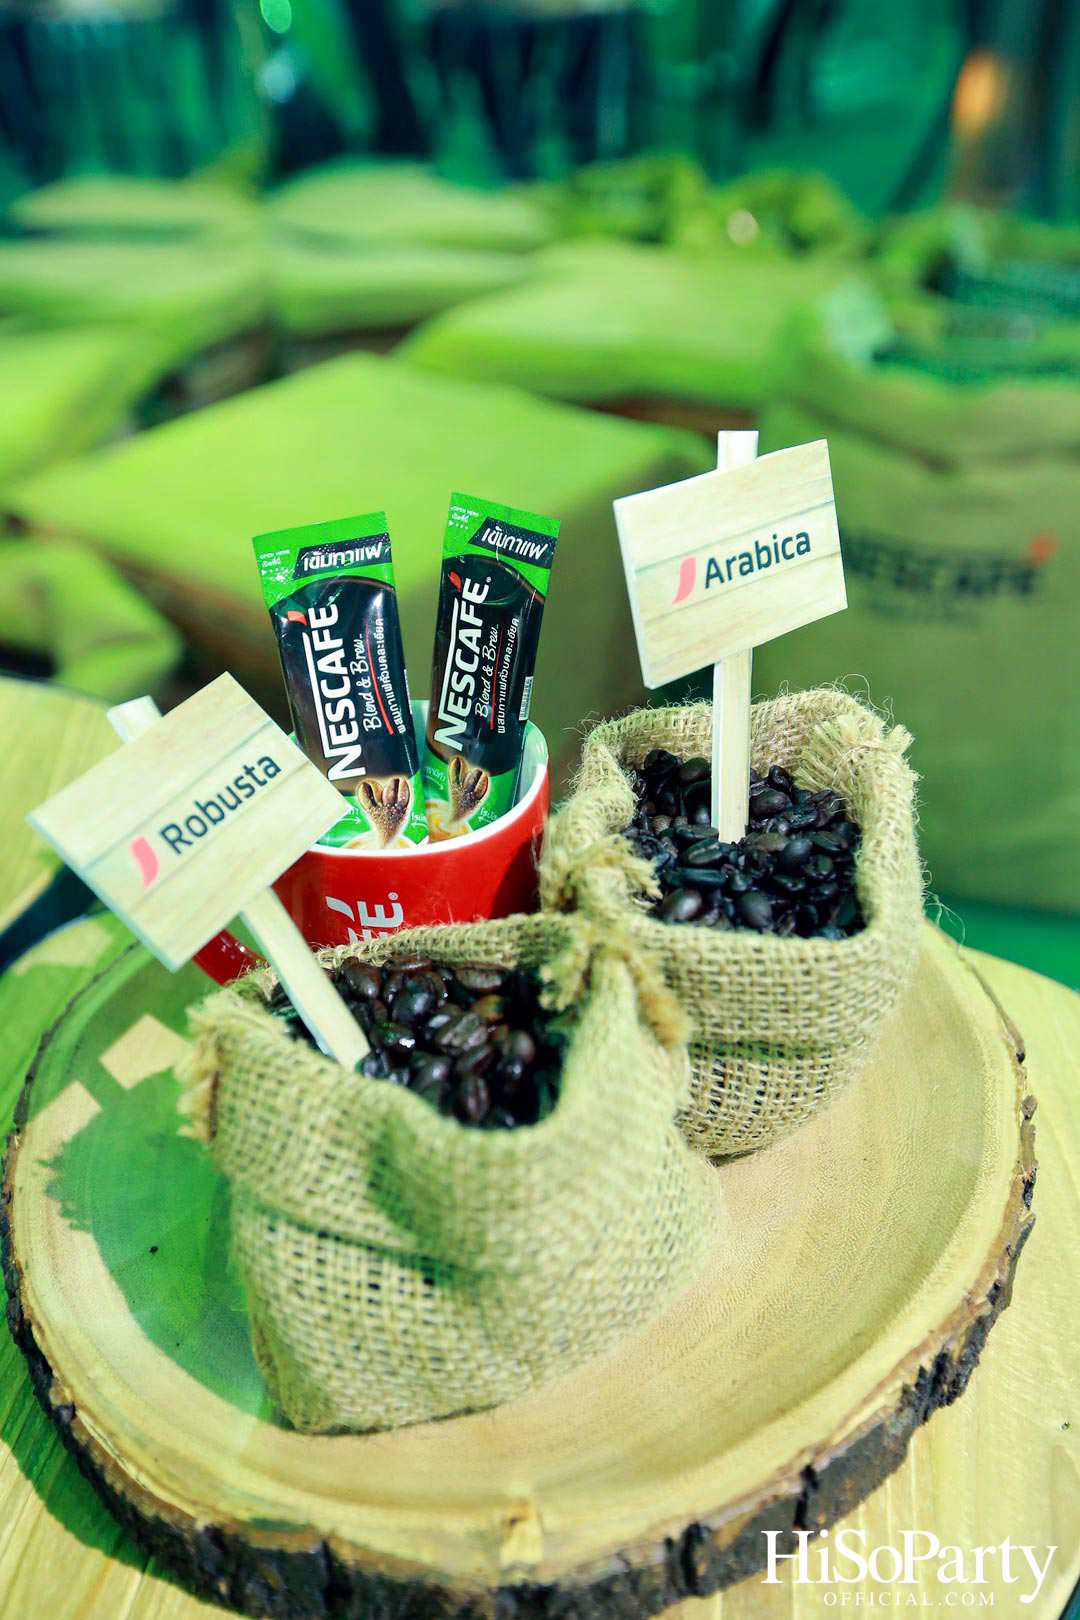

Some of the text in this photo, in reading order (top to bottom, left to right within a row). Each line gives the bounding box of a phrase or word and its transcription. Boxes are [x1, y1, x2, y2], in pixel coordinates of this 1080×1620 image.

[705, 531, 812, 589] Arabica
[350, 638, 382, 732] Blend & Brew
[474, 626, 500, 718] Blend & Brew
[159, 755, 282, 855] Robusta
